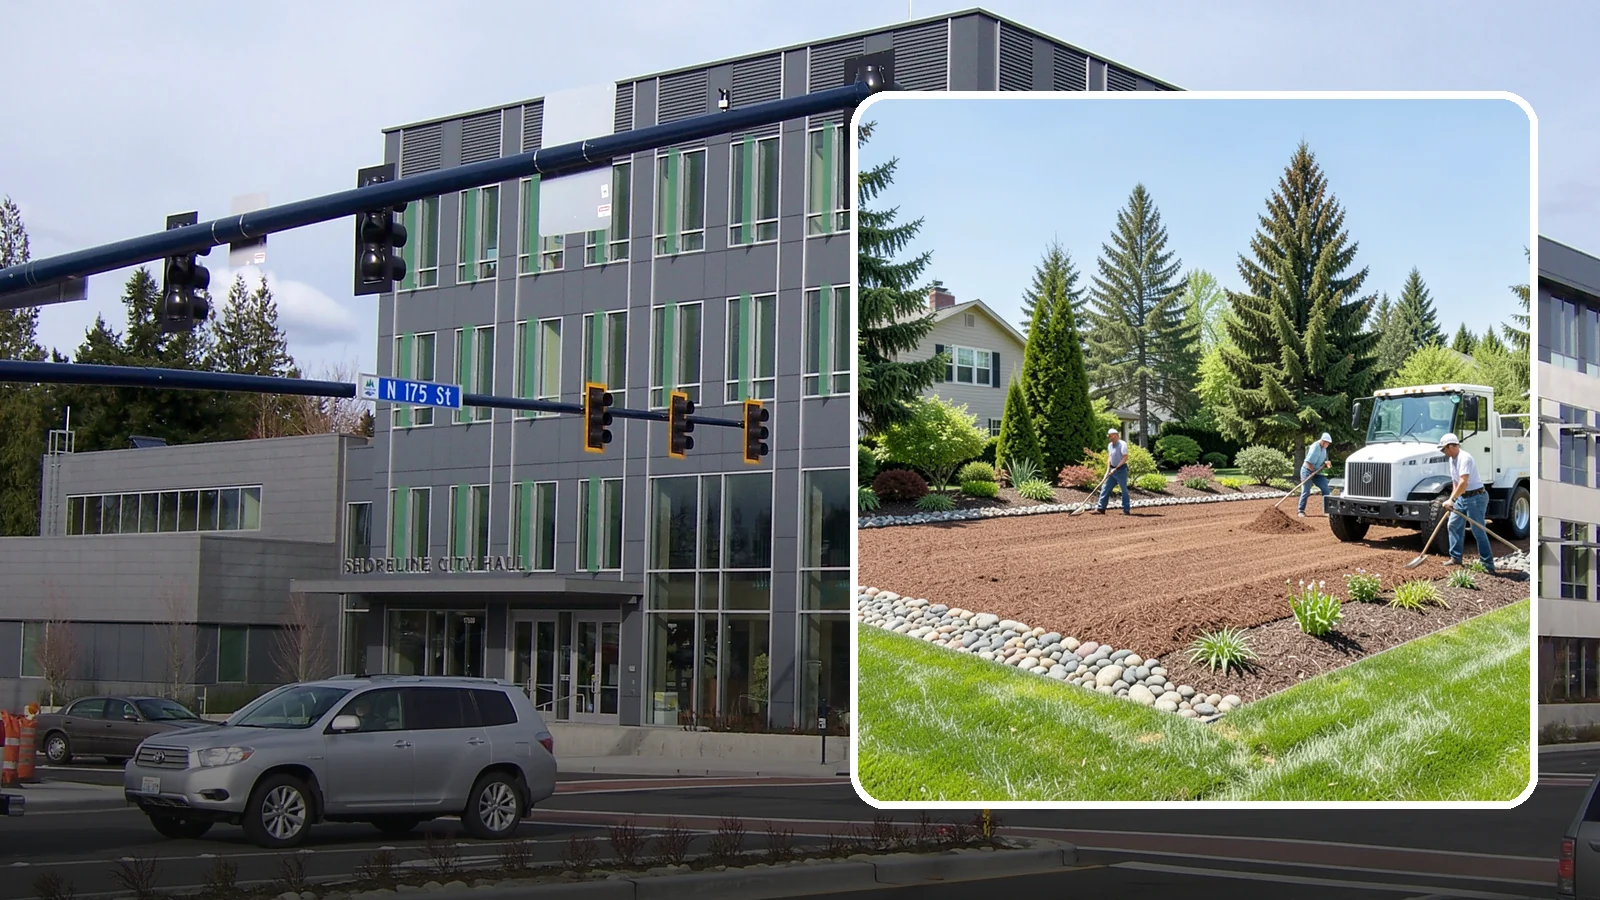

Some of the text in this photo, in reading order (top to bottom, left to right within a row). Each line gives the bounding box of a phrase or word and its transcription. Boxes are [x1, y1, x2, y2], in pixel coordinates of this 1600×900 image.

[387, 380, 452, 406] N 175 St
[344, 555, 525, 574] SHORELINE CITY HALL
